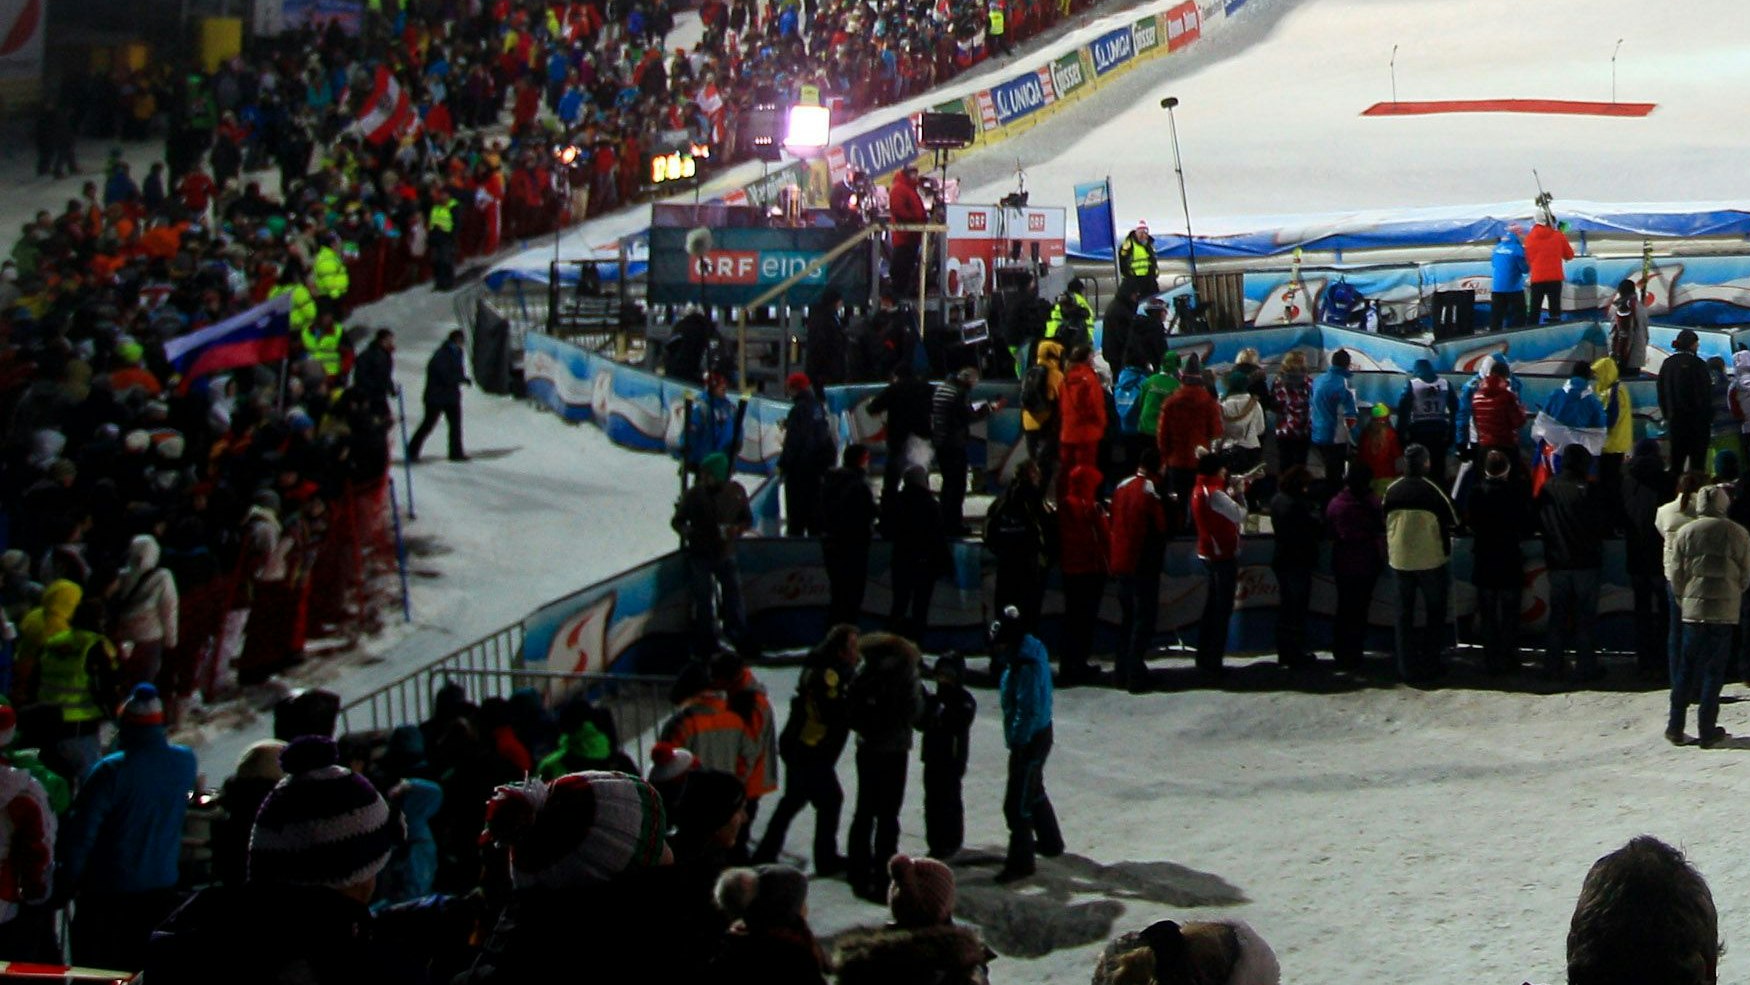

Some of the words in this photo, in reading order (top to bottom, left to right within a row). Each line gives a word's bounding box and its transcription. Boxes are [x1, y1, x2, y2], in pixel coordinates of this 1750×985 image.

[1009, 84, 1042, 113] UNIQA
[868, 129, 915, 174] UNIQA
[969, 215, 986, 227] ORF
[1029, 216, 1044, 228] ORF
[694, 253, 754, 278] ORF
[762, 254, 823, 279] eins
